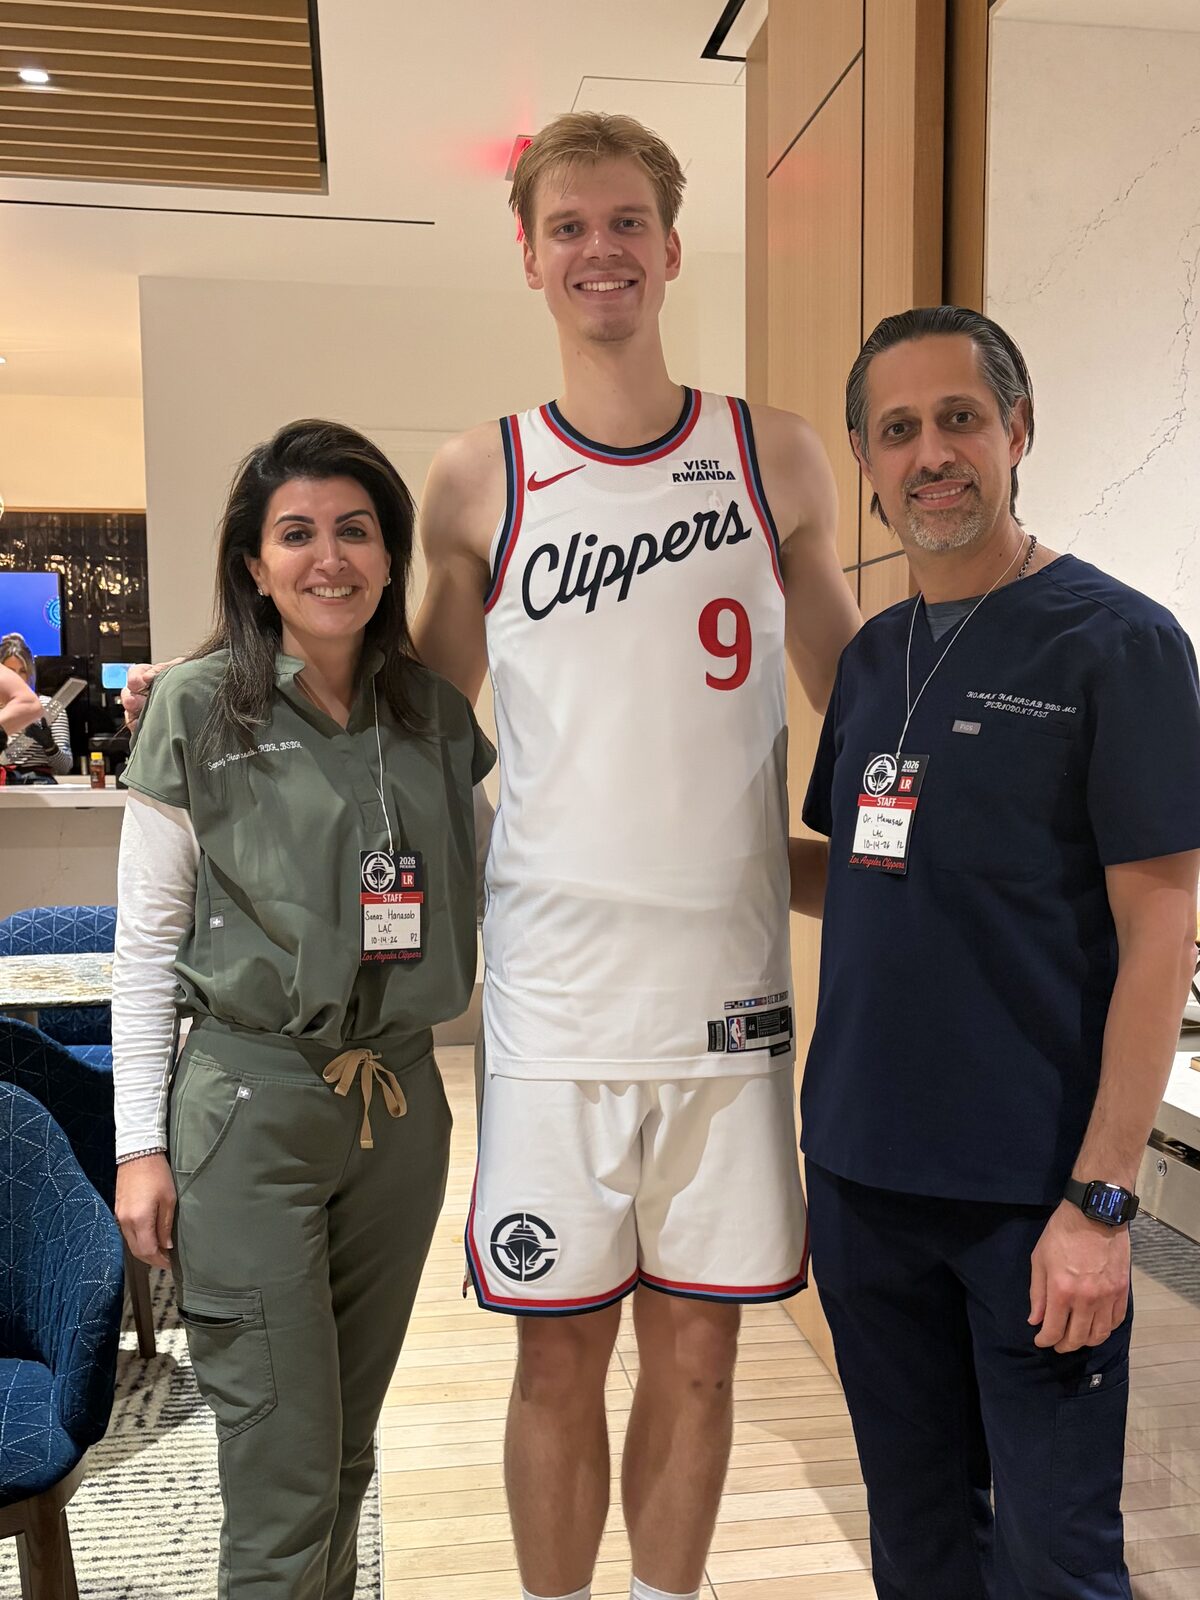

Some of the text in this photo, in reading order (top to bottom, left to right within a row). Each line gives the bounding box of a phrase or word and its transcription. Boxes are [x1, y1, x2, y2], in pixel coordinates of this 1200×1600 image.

[684, 459, 720, 471] VISIT
[672, 470, 736, 483] RWANDA
[522, 500, 752, 621] Clippers
[698, 597, 752, 691] 9
[983, 700, 1050, 718] PERIODONTIST
[1044, 703, 1061, 712] DDS
[1062, 706, 1077, 714] MS
[902, 760, 920, 769] 2026
[900, 778, 912, 789] LR
[876, 796, 898, 807] STAFF
[399, 856, 416, 865] 2026
[849, 854, 905, 870] Los Angeles Clippers
[403, 874, 413, 885] LR
[382, 893, 403, 903] STAFF
[377, 923, 392, 933] LAC
[410, 932, 418, 942] P2
[361, 950, 422, 963] Los Angeles Clippers
